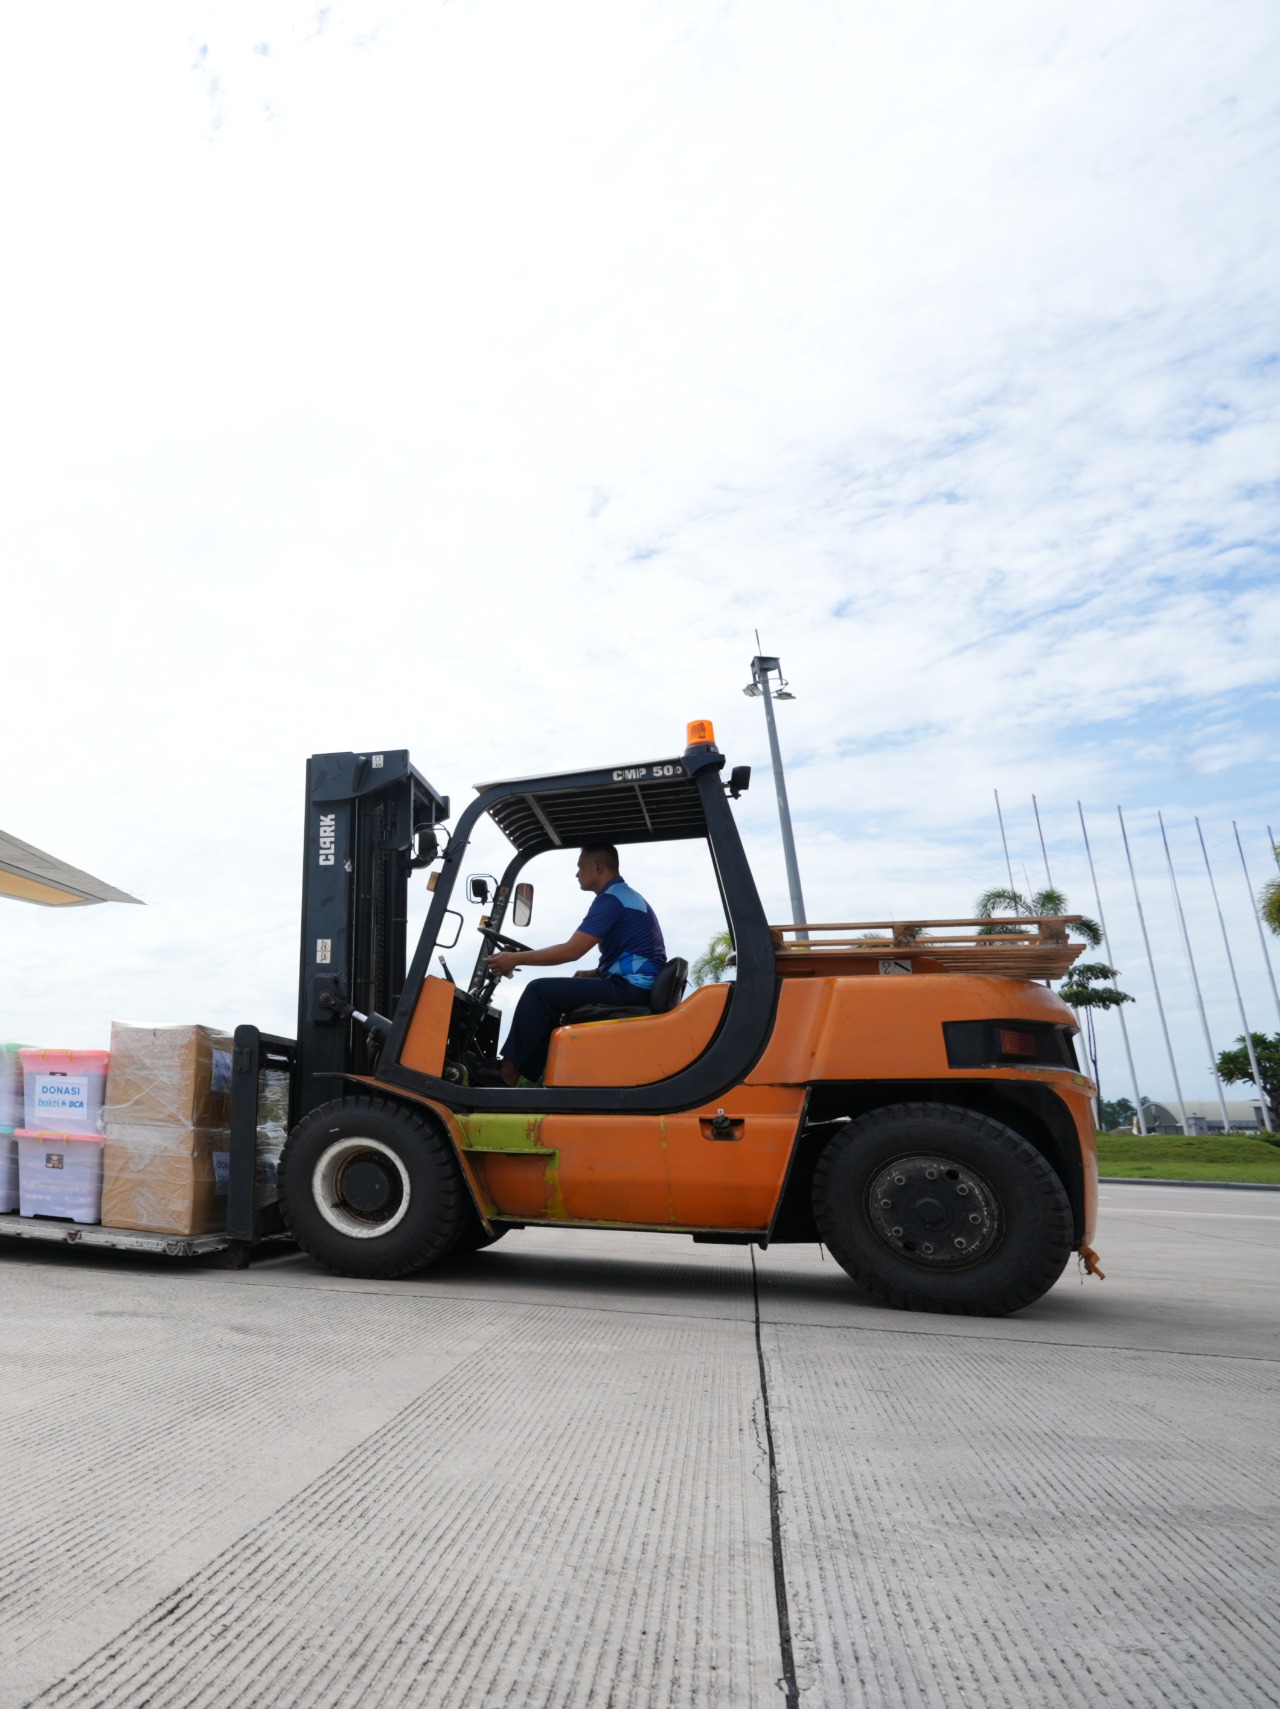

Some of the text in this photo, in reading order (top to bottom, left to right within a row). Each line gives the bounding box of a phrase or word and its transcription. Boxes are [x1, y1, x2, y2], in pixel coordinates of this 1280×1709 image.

[612, 767, 647, 782] CMP
[318, 813, 336, 866] CLARK
[41, 1085, 81, 1096] DONASI
[37, 1097, 84, 1108] bakti BCA
